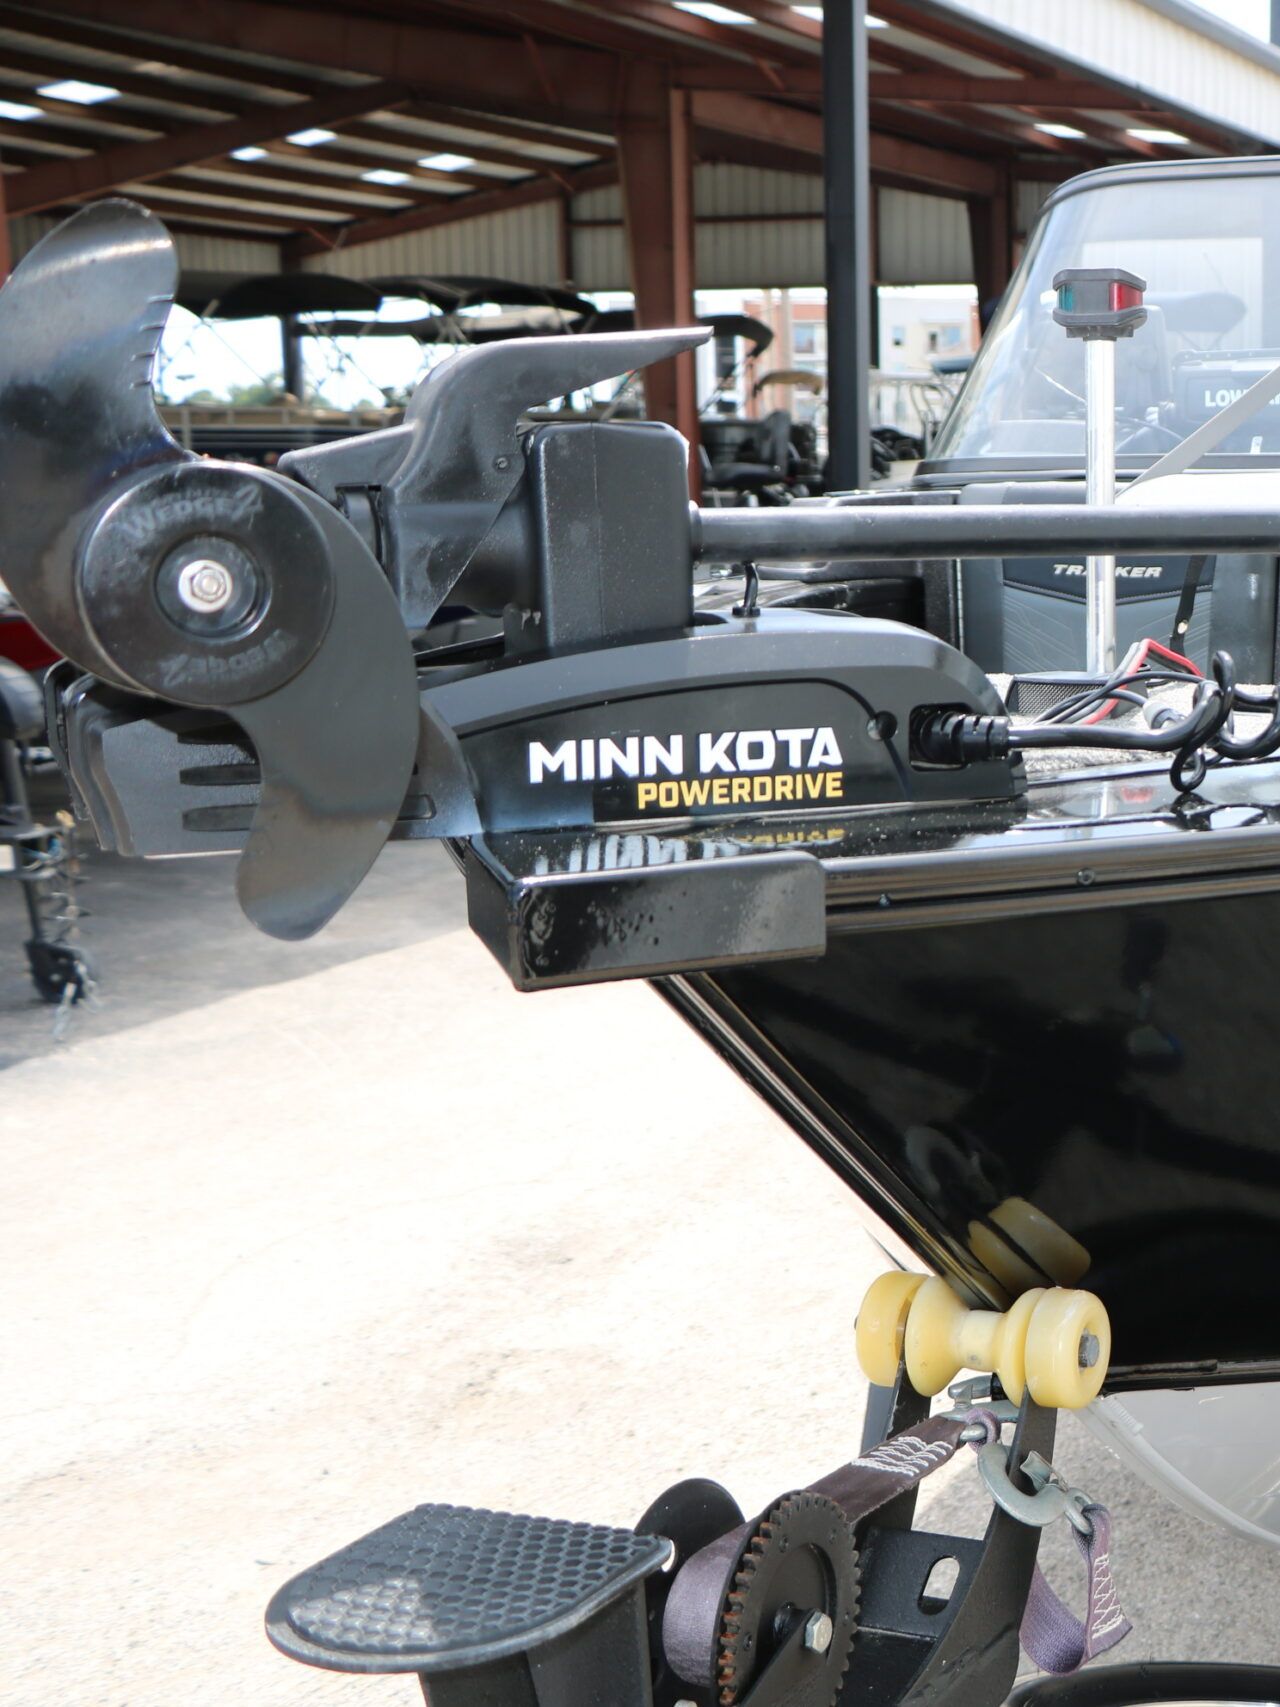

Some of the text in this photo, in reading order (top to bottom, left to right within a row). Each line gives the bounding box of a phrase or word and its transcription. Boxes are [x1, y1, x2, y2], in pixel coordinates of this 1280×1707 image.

[1053, 564, 1163, 578] TRKER
[528, 726, 844, 785] MINN KOTA
[637, 771, 844, 810] POWERDRIVE
